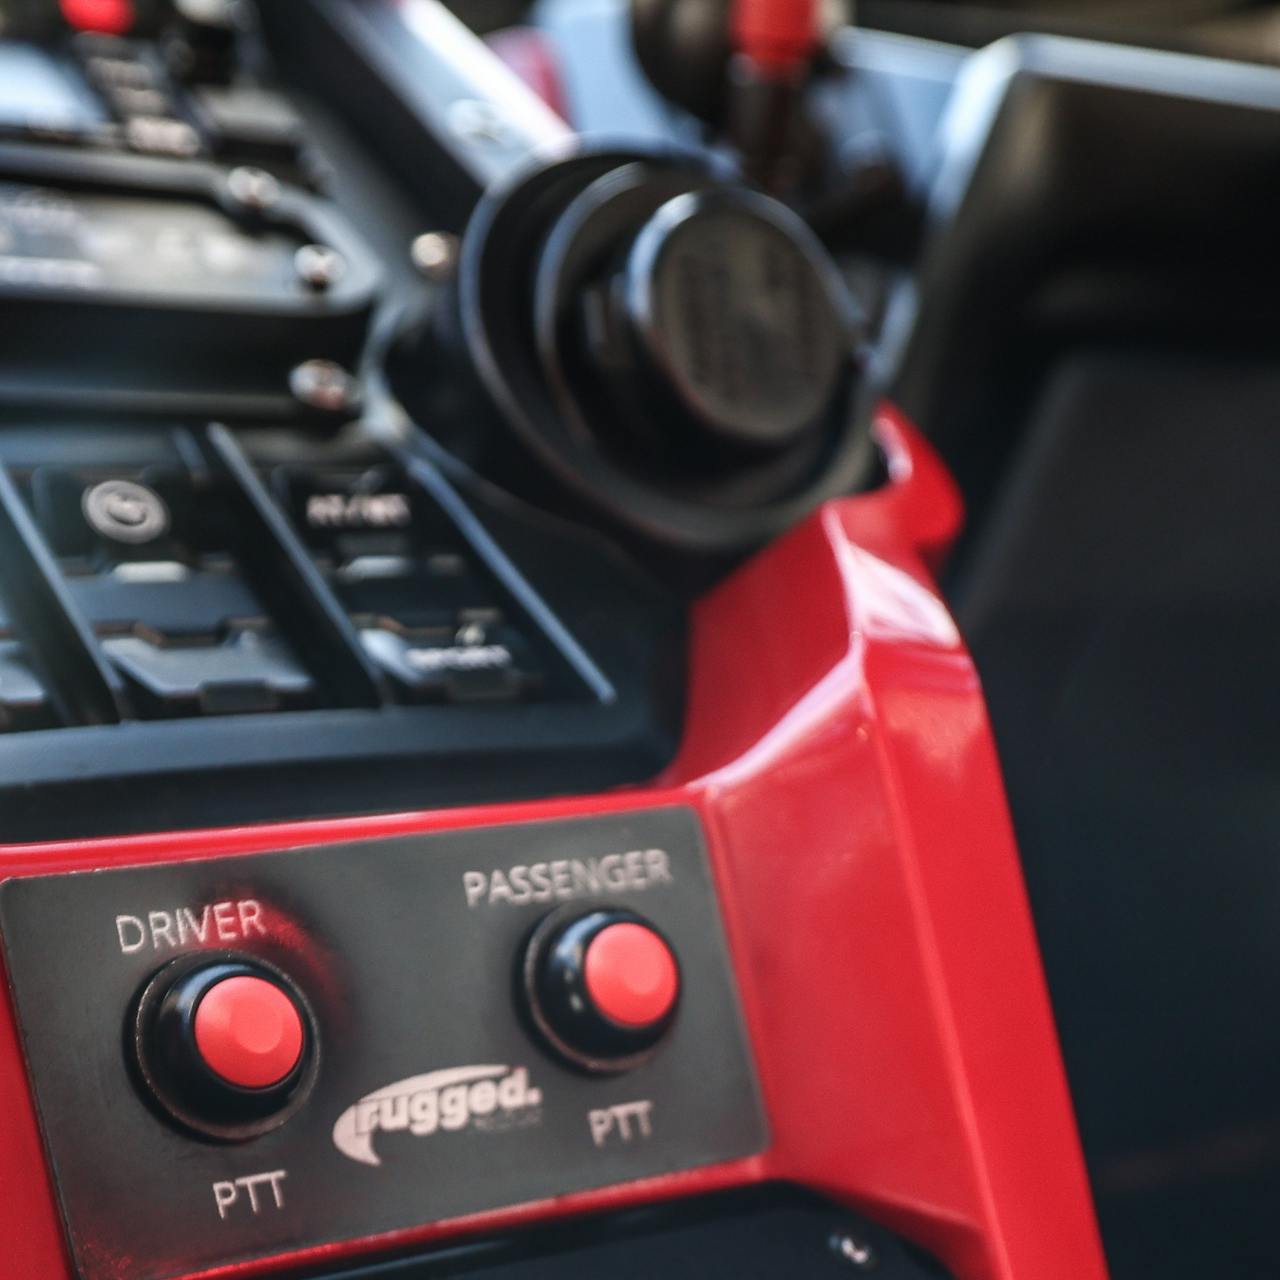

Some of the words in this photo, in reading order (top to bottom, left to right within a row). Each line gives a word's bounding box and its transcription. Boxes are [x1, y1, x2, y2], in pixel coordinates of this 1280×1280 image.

[462, 848, 673, 908] PASSENGER
[115, 899, 267, 953] DRIVER
[587, 1099, 652, 1148] PTT
[212, 1169, 287, 1220] PTT
